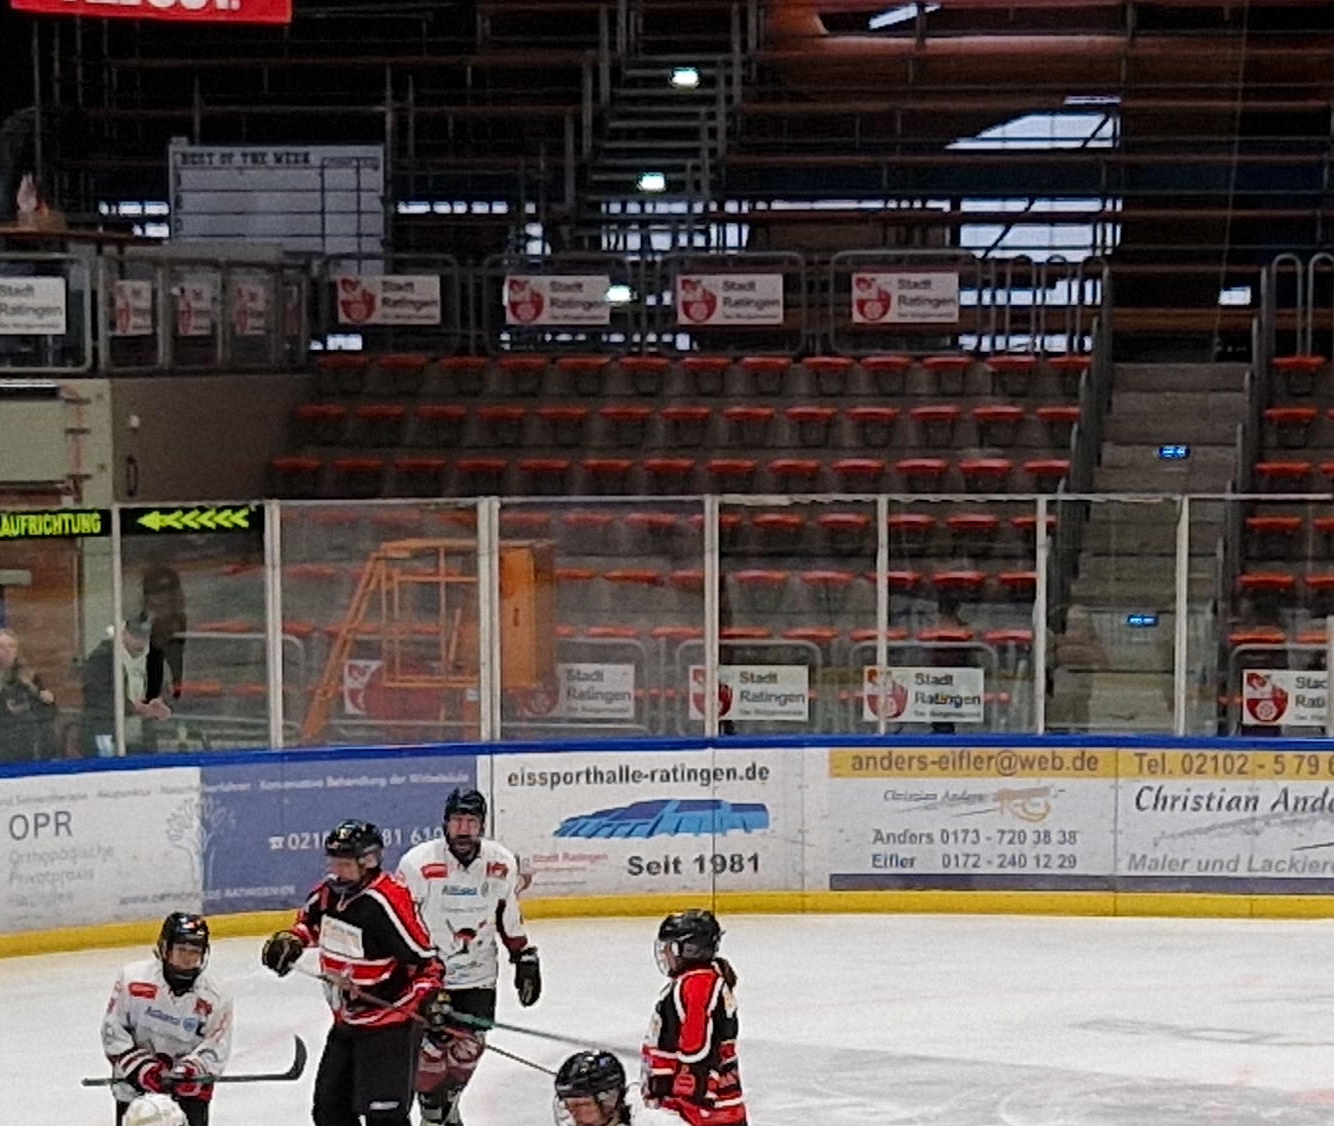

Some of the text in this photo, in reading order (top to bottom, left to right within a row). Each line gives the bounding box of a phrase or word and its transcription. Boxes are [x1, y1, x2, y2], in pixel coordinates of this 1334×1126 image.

[507, 761, 770, 790] eissporthalle-ratingen.de
[851, 751, 1099, 777] anders-eifler@web.de
[1134, 753, 1173, 775] Tel.
[1181, 753, 1249, 776] 02102
[1273, 754, 1286, 776] 5
[1293, 754, 1321, 777] 79
[1134, 784, 1260, 813] Christian
[8, 810, 74, 841] OPR
[872, 829, 935, 845] Anders
[940, 828, 981, 845] 0173
[997, 828, 1027, 845] 720
[1032, 829, 1052, 845] 38
[1057, 829, 1078, 845] 38
[627, 853, 760, 876] Seit 1981
[871, 853, 916, 869] Eifler
[941, 854, 982, 869] 0172
[997, 854, 1028, 869] 240
[1033, 854, 1052, 869] 12
[1127, 852, 1190, 872] Maler
[1195, 853, 1241, 874] und
